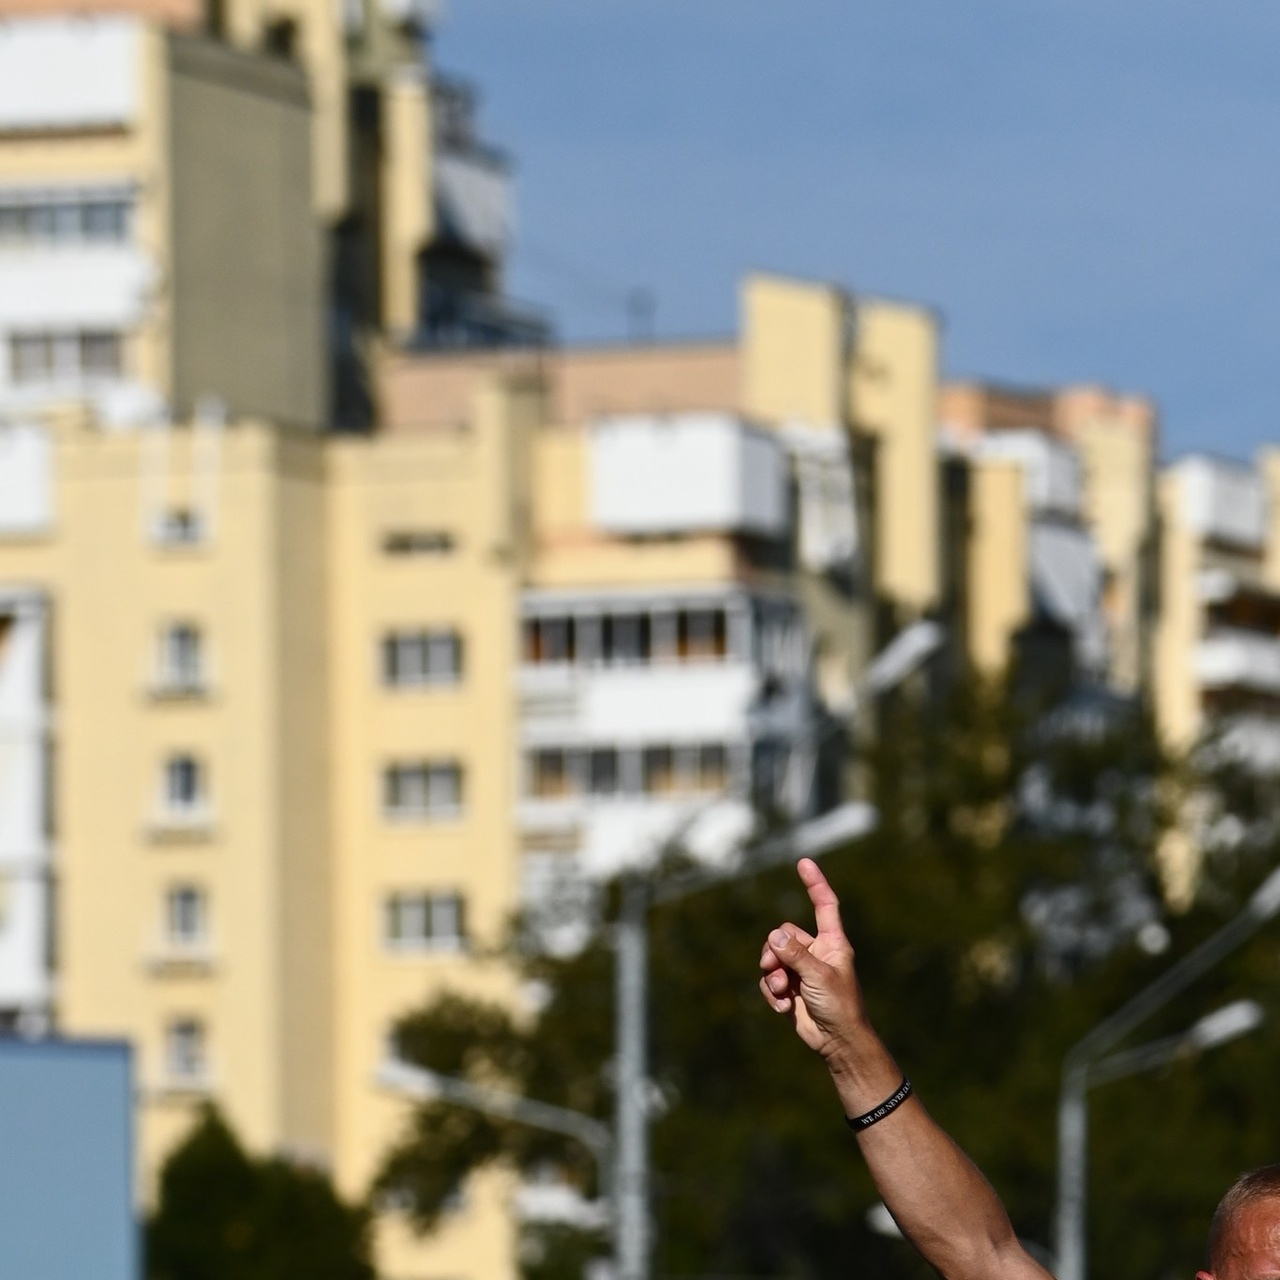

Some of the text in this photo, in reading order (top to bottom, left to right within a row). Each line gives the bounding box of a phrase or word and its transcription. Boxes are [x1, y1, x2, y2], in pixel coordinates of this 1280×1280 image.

[861, 1115, 875, 1125] WE
[874, 1106, 888, 1120] ARE
[885, 1091, 905, 1110] NEVER
